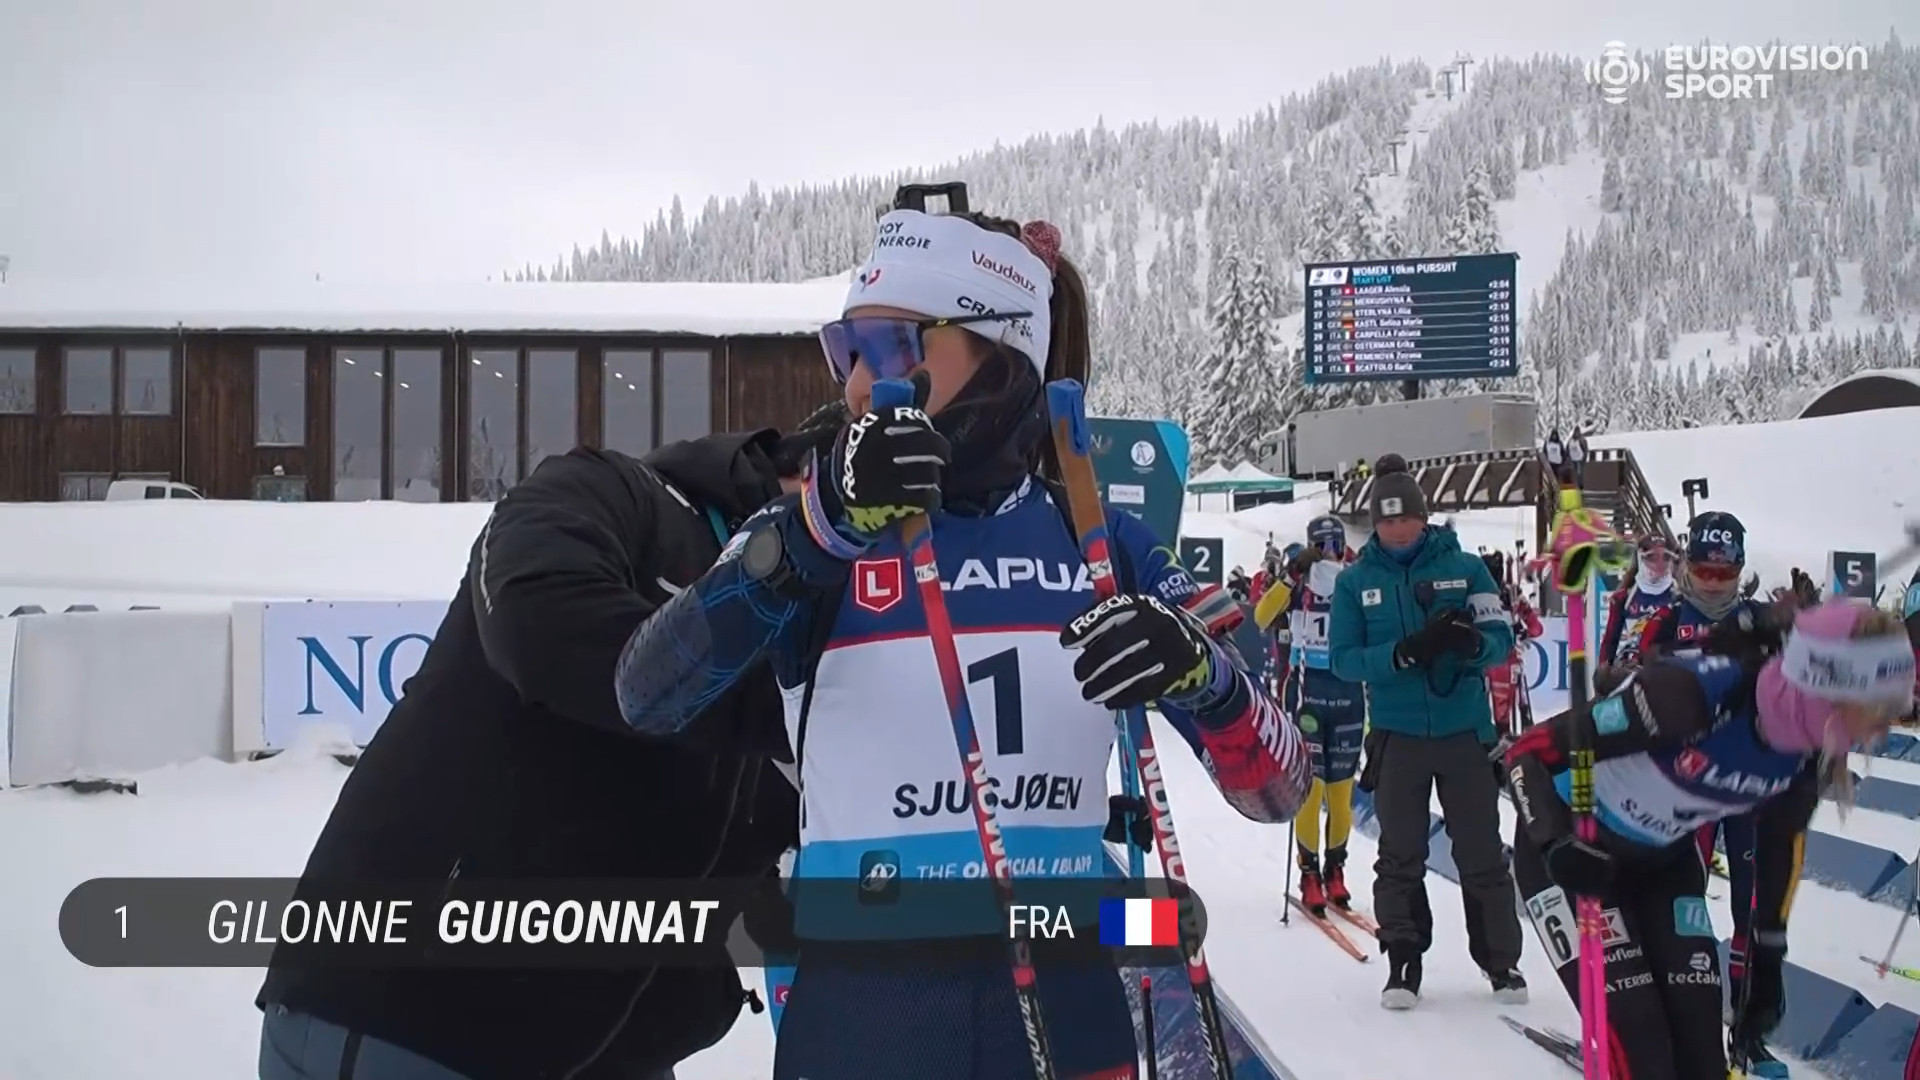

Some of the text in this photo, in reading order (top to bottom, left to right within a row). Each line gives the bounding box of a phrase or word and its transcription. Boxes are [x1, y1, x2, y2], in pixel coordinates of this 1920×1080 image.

[879, 236, 932, 250] NERGIE
[972, 249, 1037, 296] Vaudaux
[1352, 262, 1457, 277] WOMEN 10km PURSUIT
[1353, 276, 1376, 284] START
[957, 295, 1020, 328] CRAT
[1193, 547, 1211, 573] 2
[1846, 560, 1863, 587] 5
[866, 571, 891, 598] L
[940, 557, 1095, 592] APUA
[967, 646, 1024, 756] 1
[916, 863, 958, 879] THE
[963, 856, 1046, 879] OICIAL
[1544, 915, 1572, 962] 6
[1603, 946, 1644, 964] ufland
